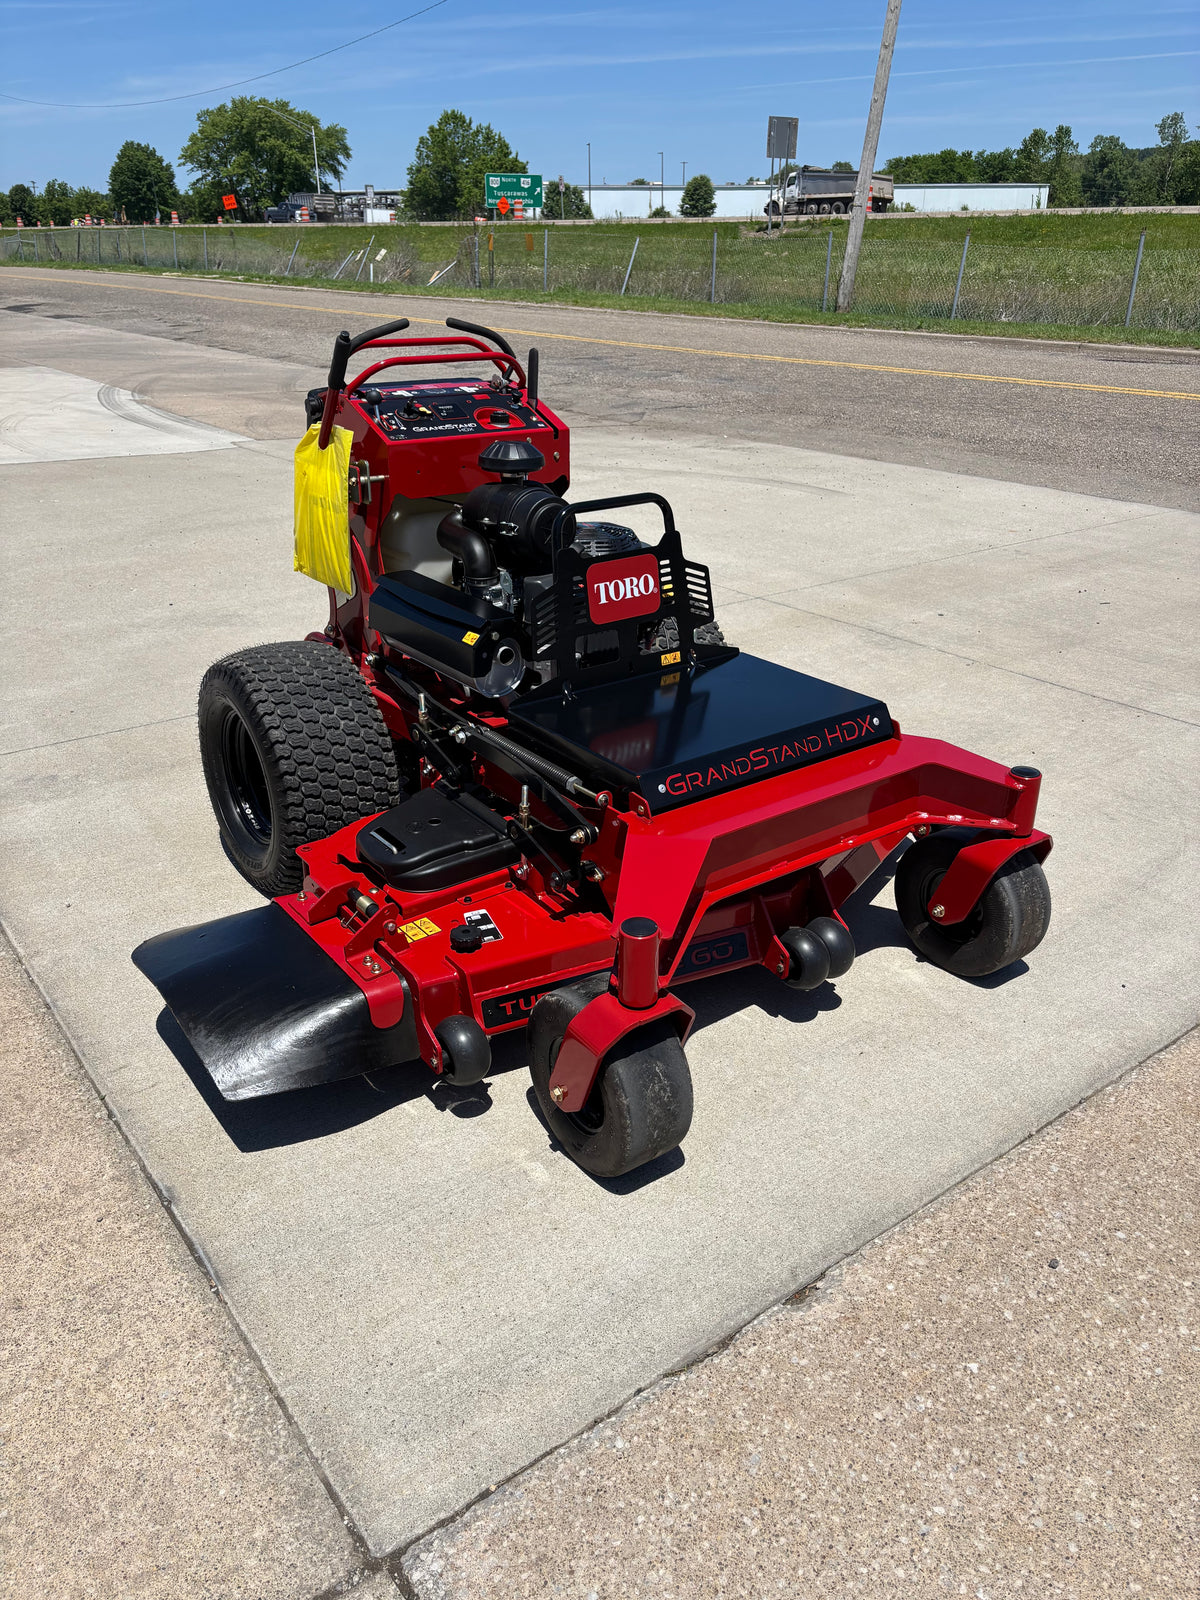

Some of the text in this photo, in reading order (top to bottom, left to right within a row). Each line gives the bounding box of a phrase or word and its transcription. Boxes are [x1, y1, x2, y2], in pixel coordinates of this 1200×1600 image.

[594, 573, 655, 605] TORO
[824, 715, 875, 747] HDX
[691, 942, 733, 966] 60
